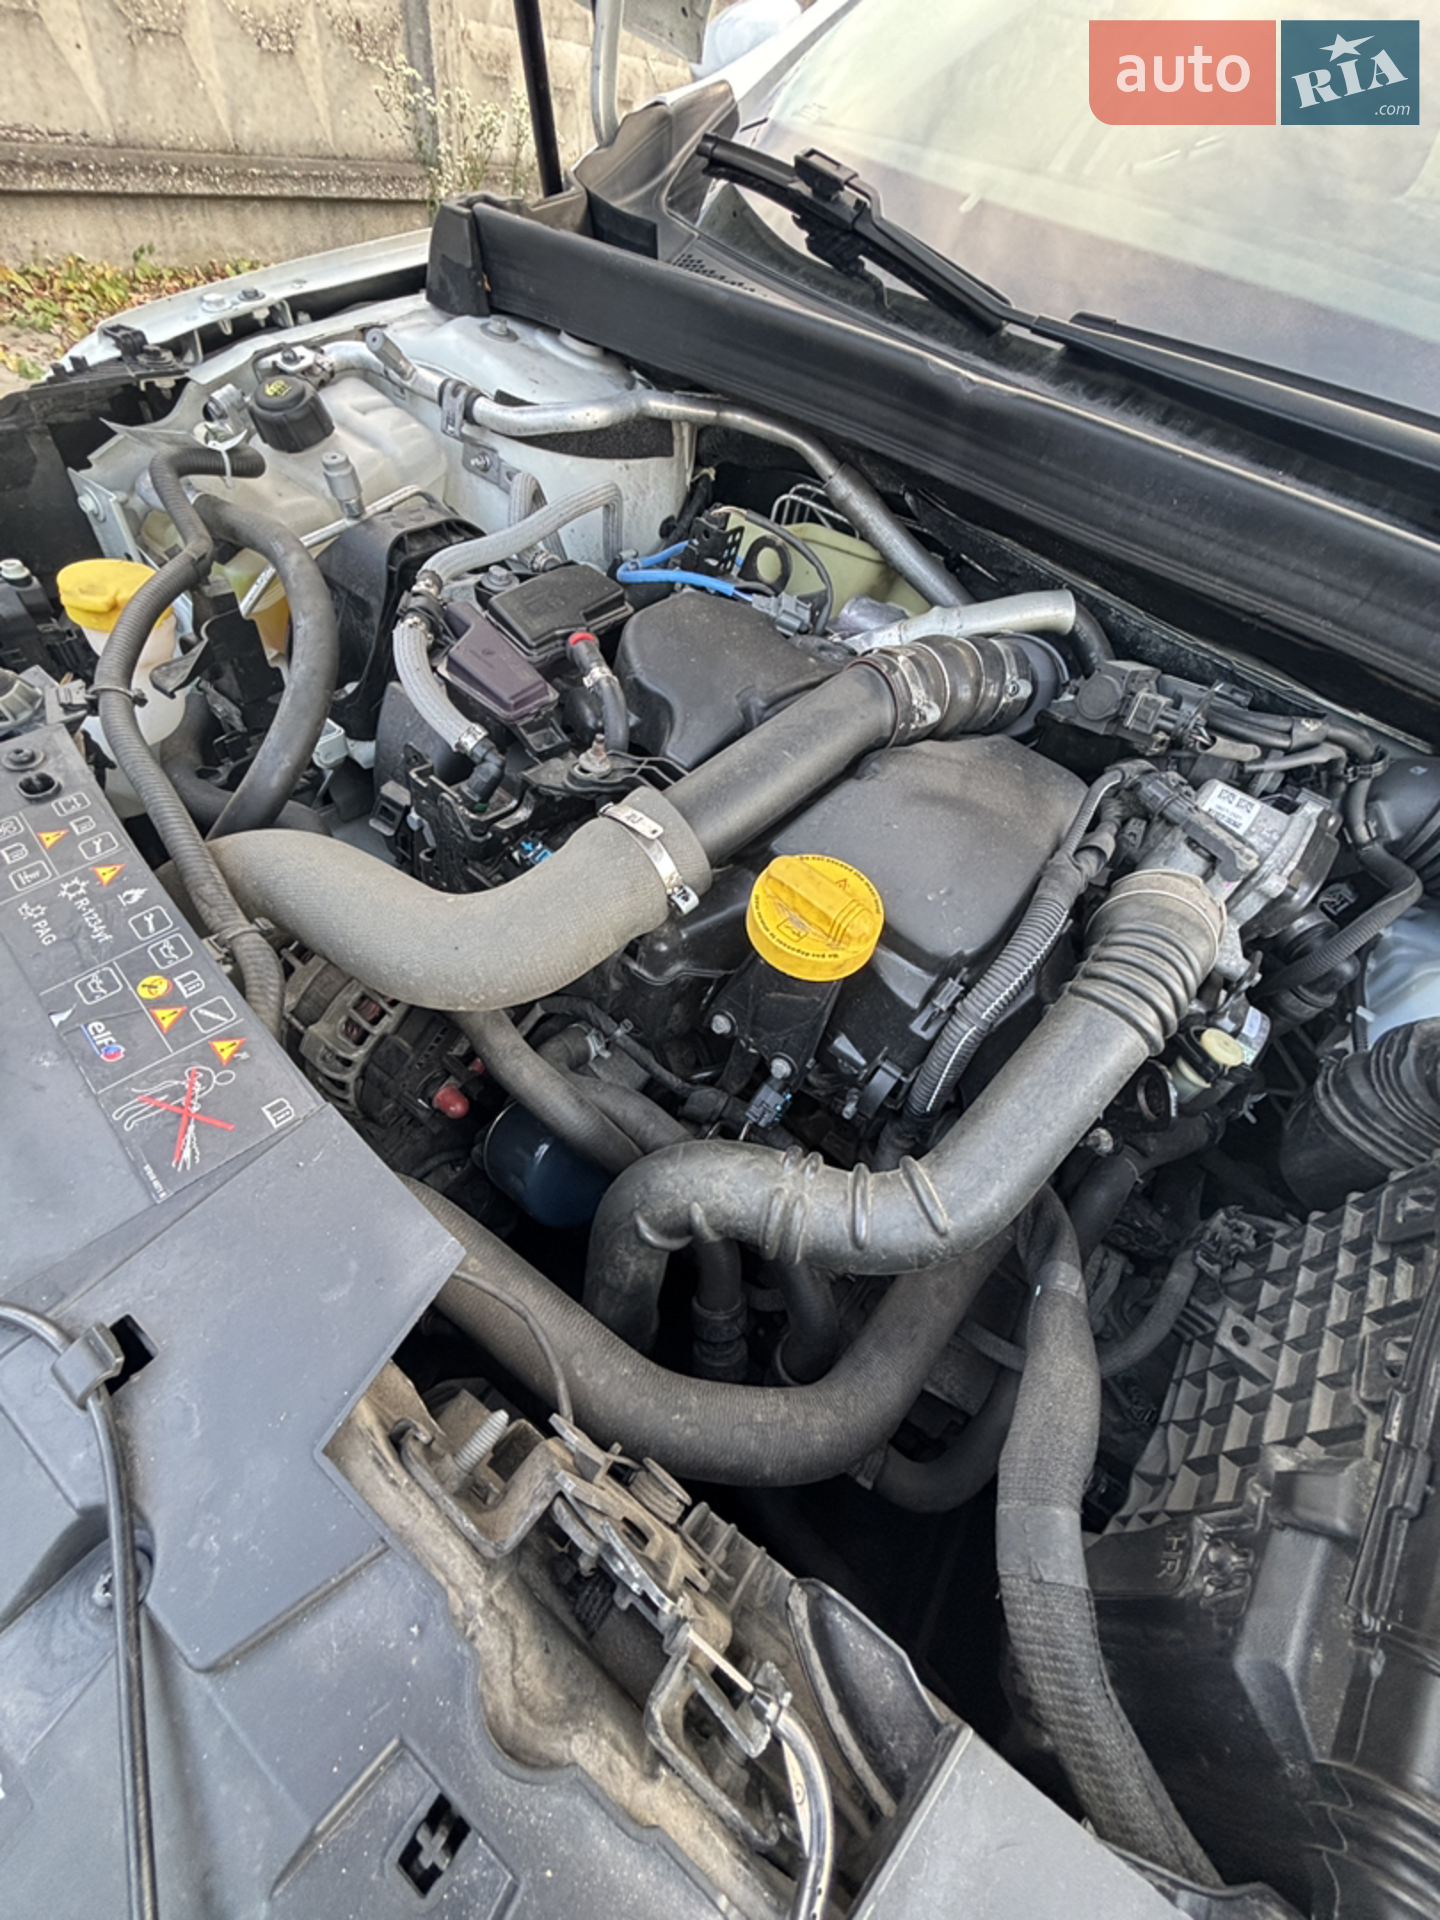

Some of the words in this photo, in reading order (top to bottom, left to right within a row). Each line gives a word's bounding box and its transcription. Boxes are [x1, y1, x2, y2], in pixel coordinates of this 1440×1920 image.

[32, 919, 57, 946] PAG
[74, 897, 114, 943] R-1234yf
[87, 1021, 117, 1047] elf
